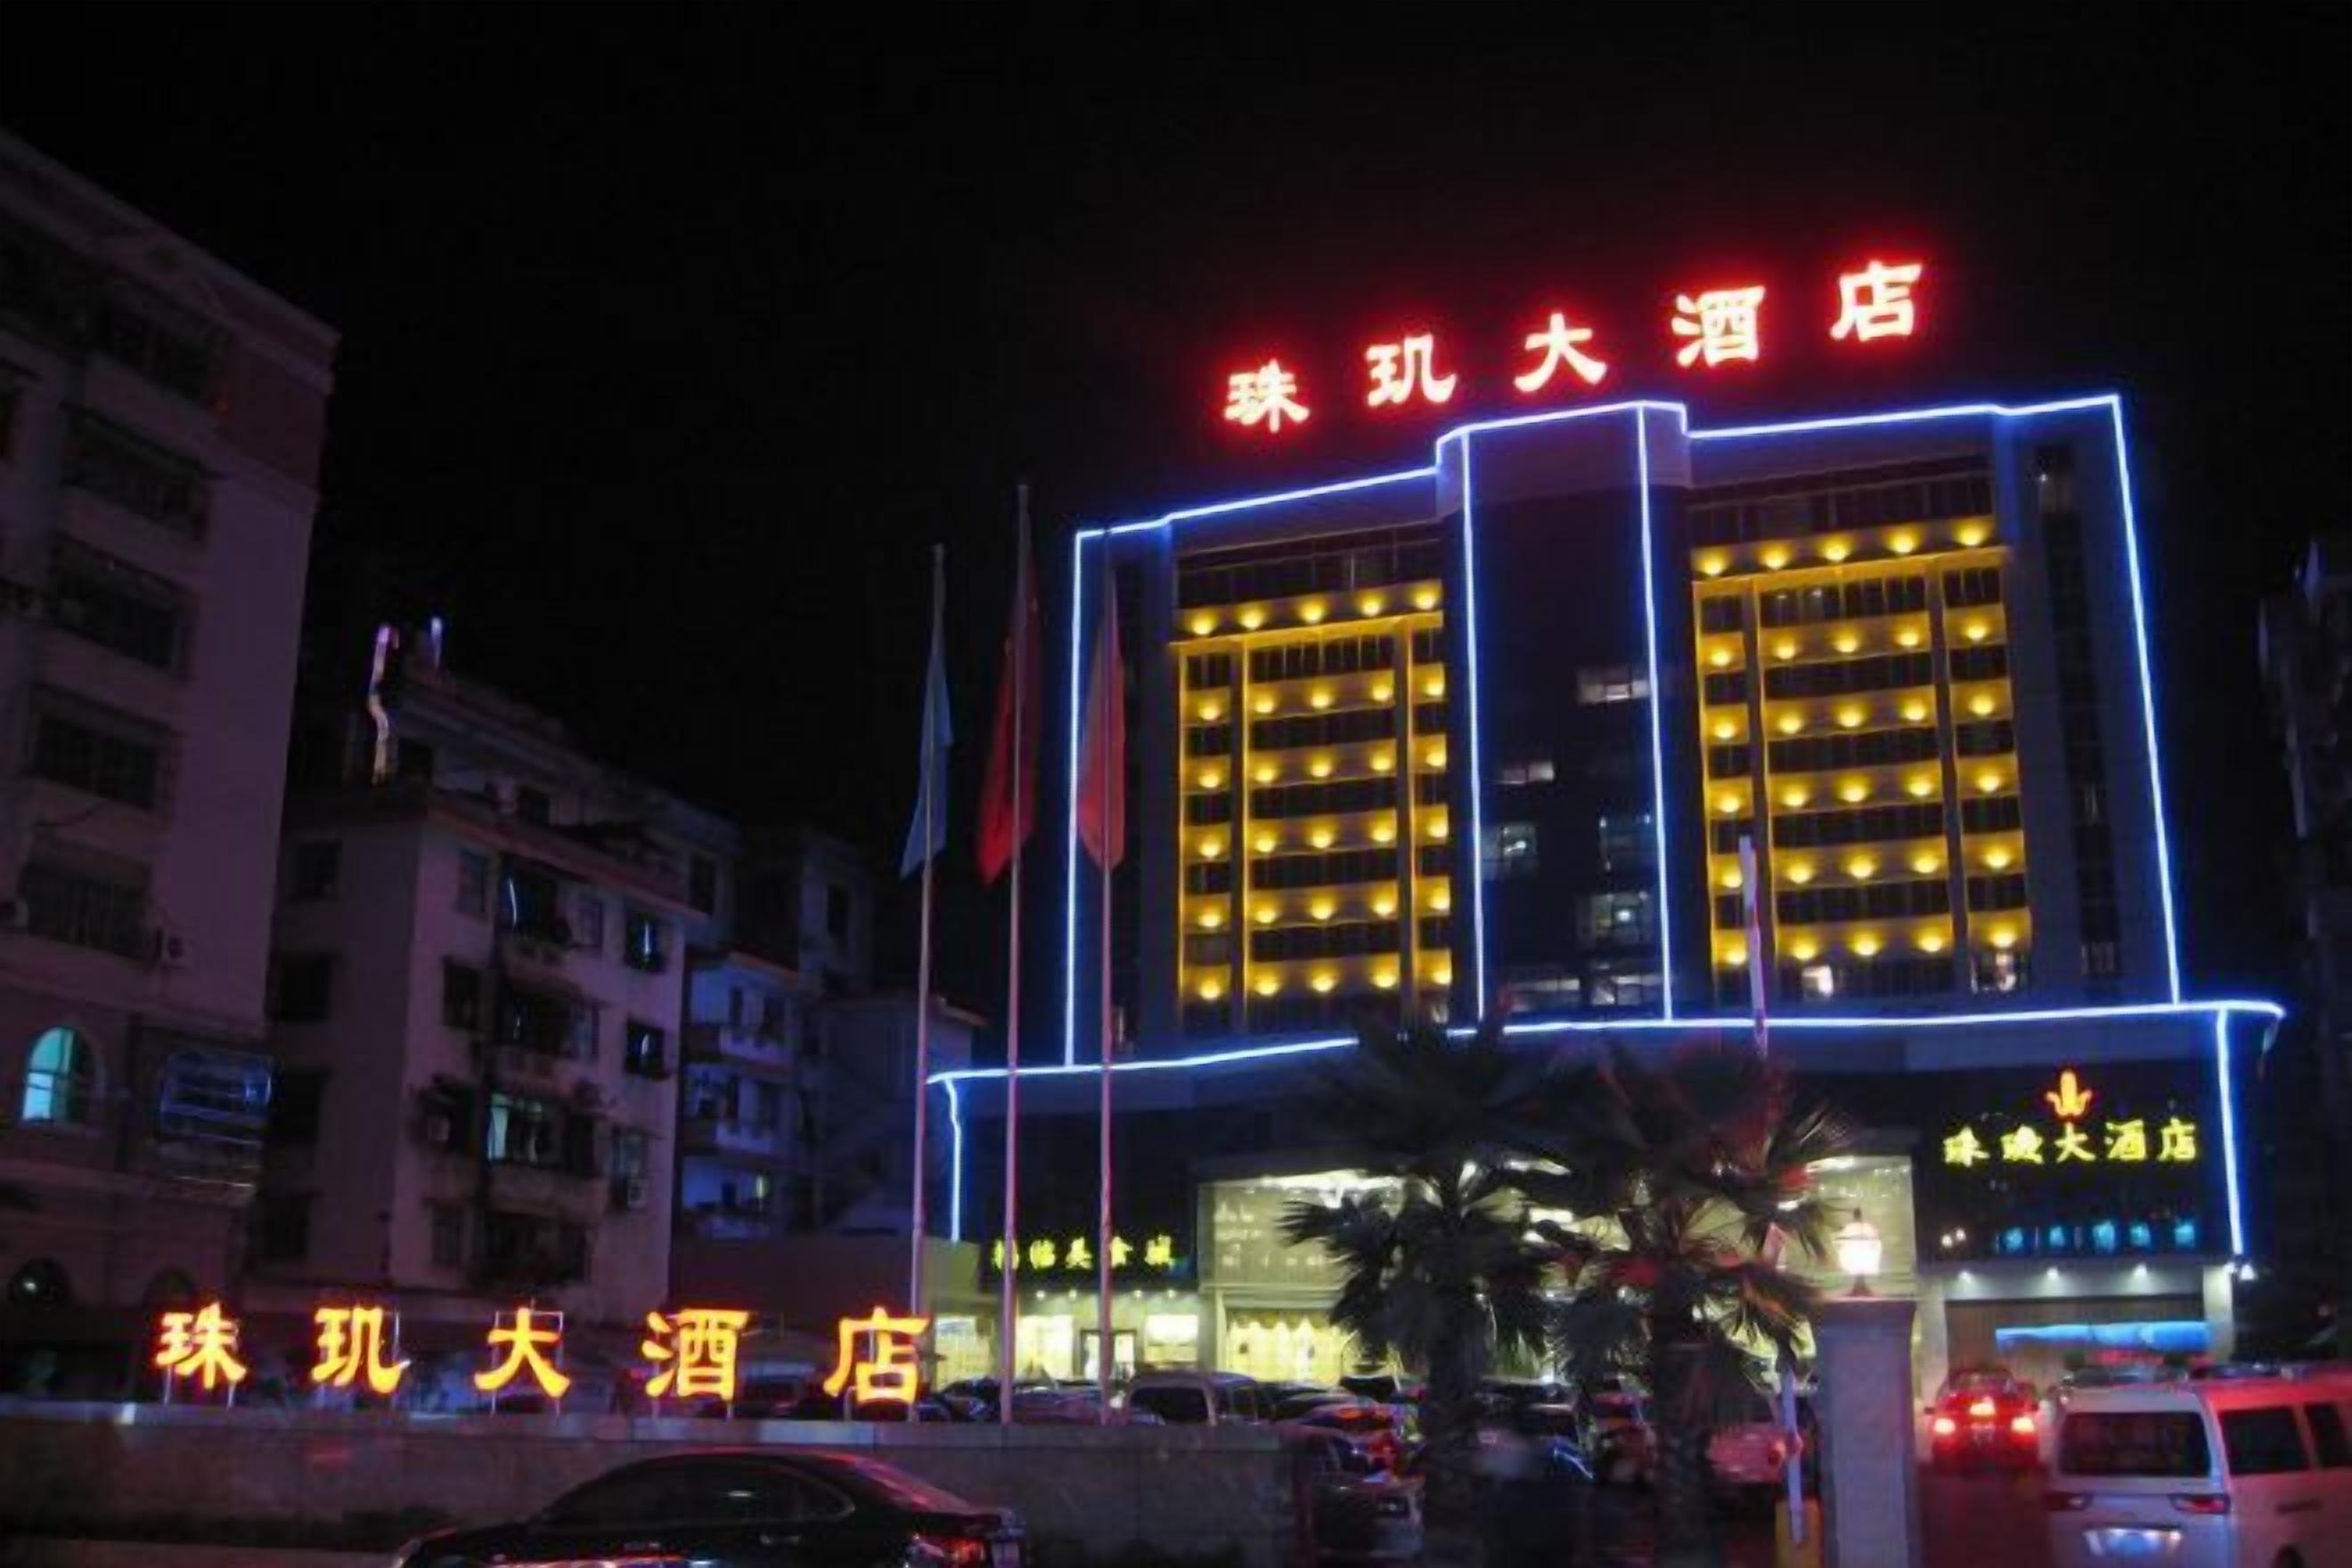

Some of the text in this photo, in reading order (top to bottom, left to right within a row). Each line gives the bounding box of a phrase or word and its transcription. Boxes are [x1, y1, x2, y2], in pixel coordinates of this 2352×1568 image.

[1226, 263, 1921, 429] 珠玑大酒店
[156, 1303, 928, 1403] 珠玑大酒店
